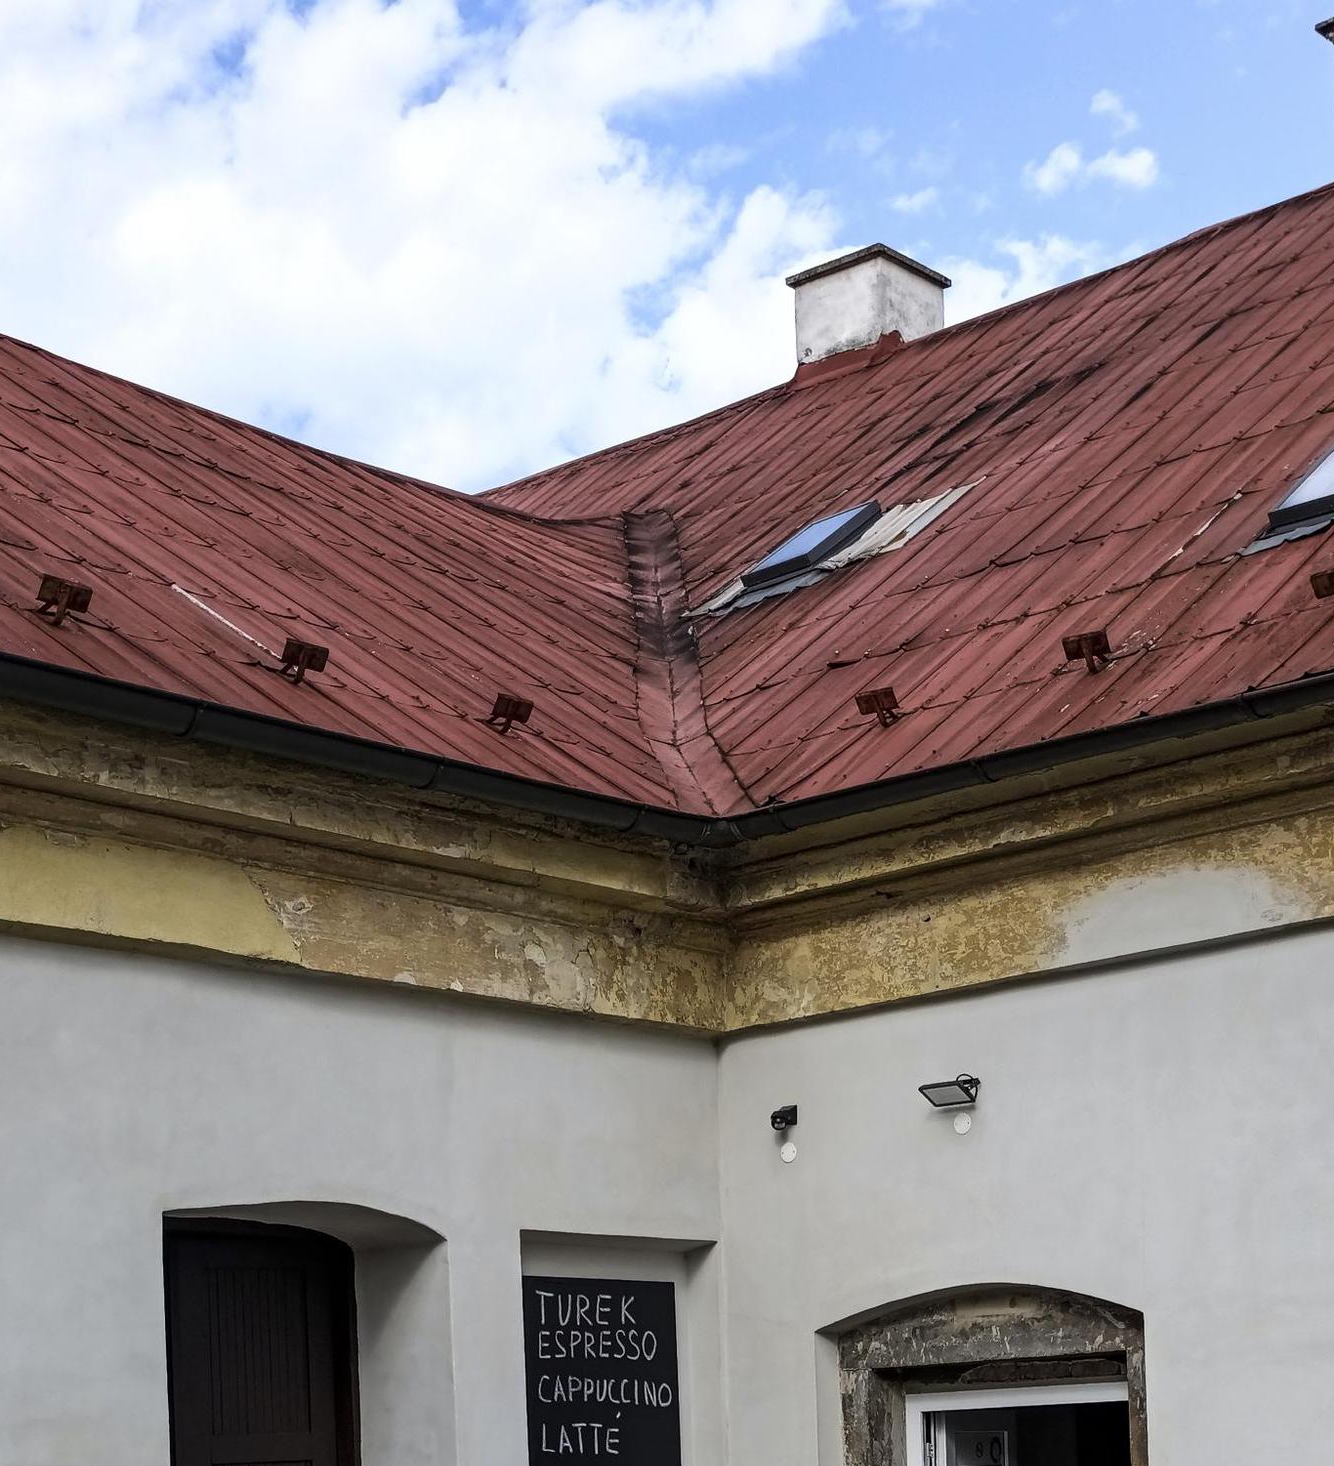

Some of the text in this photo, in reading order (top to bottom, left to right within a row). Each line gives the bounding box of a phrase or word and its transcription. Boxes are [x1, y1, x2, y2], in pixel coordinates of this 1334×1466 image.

[535, 1290, 636, 1326] TUREK
[539, 1330, 657, 1360] ESPRESSO
[539, 1375, 672, 1408] CAPPUCCINO
[542, 1412, 620, 1454] LATTÉ
